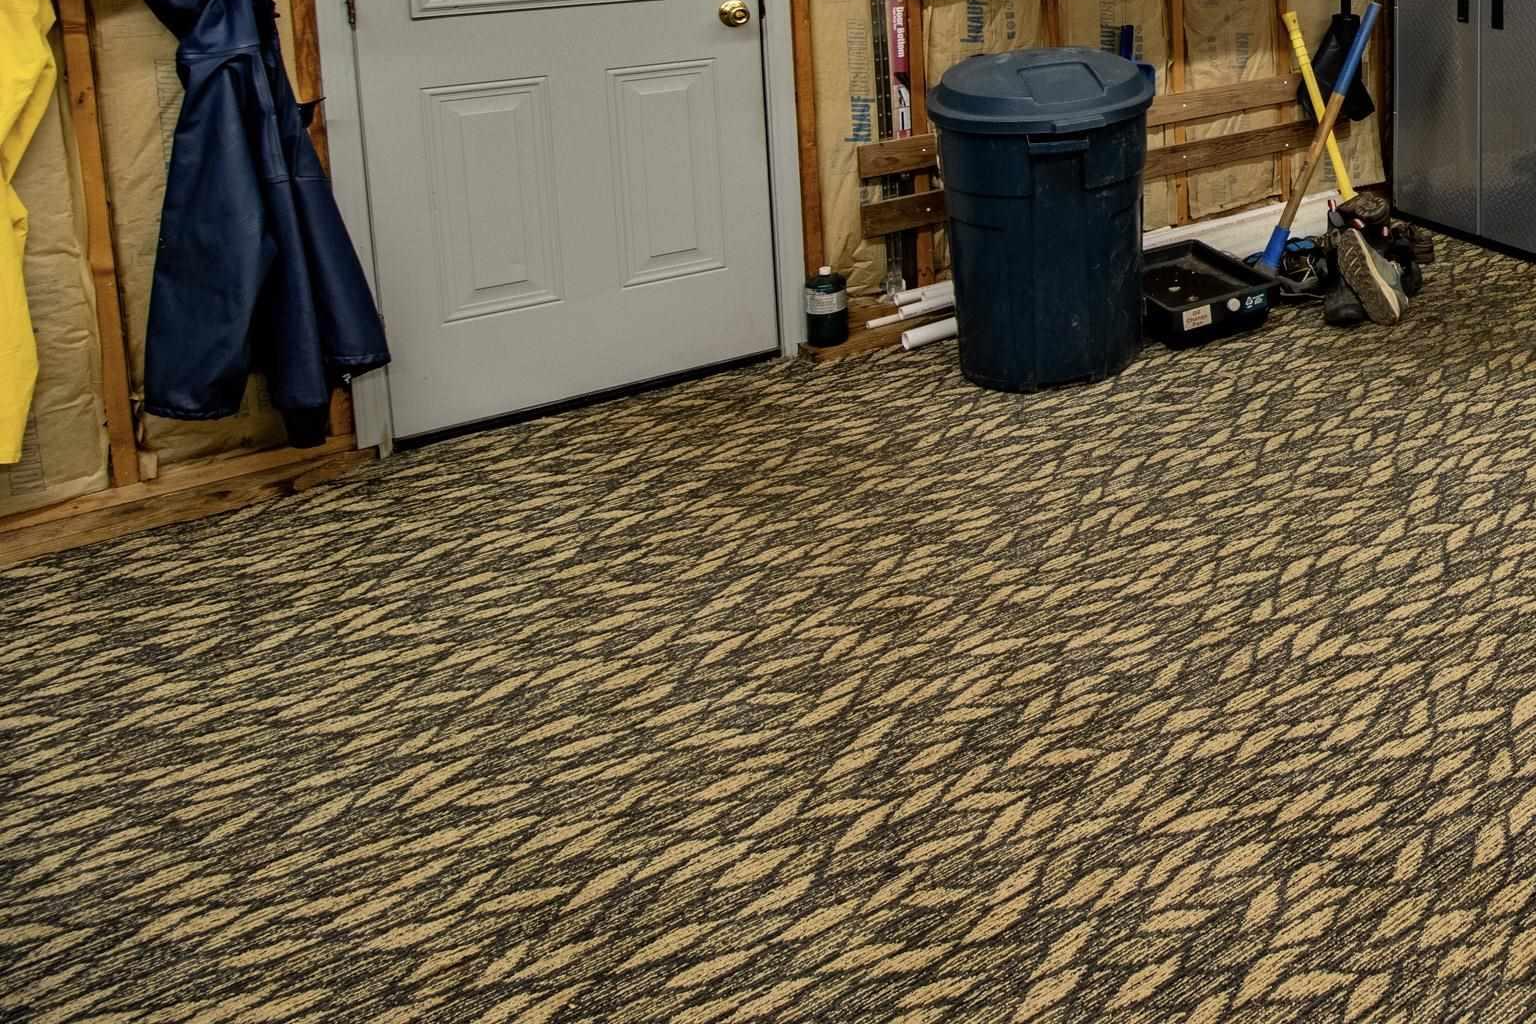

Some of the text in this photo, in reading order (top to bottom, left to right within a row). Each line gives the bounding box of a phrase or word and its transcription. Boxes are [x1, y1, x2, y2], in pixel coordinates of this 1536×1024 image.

[896, 6, 905, 58] Door Bottom
[845, 94, 876, 144] KNAUF
